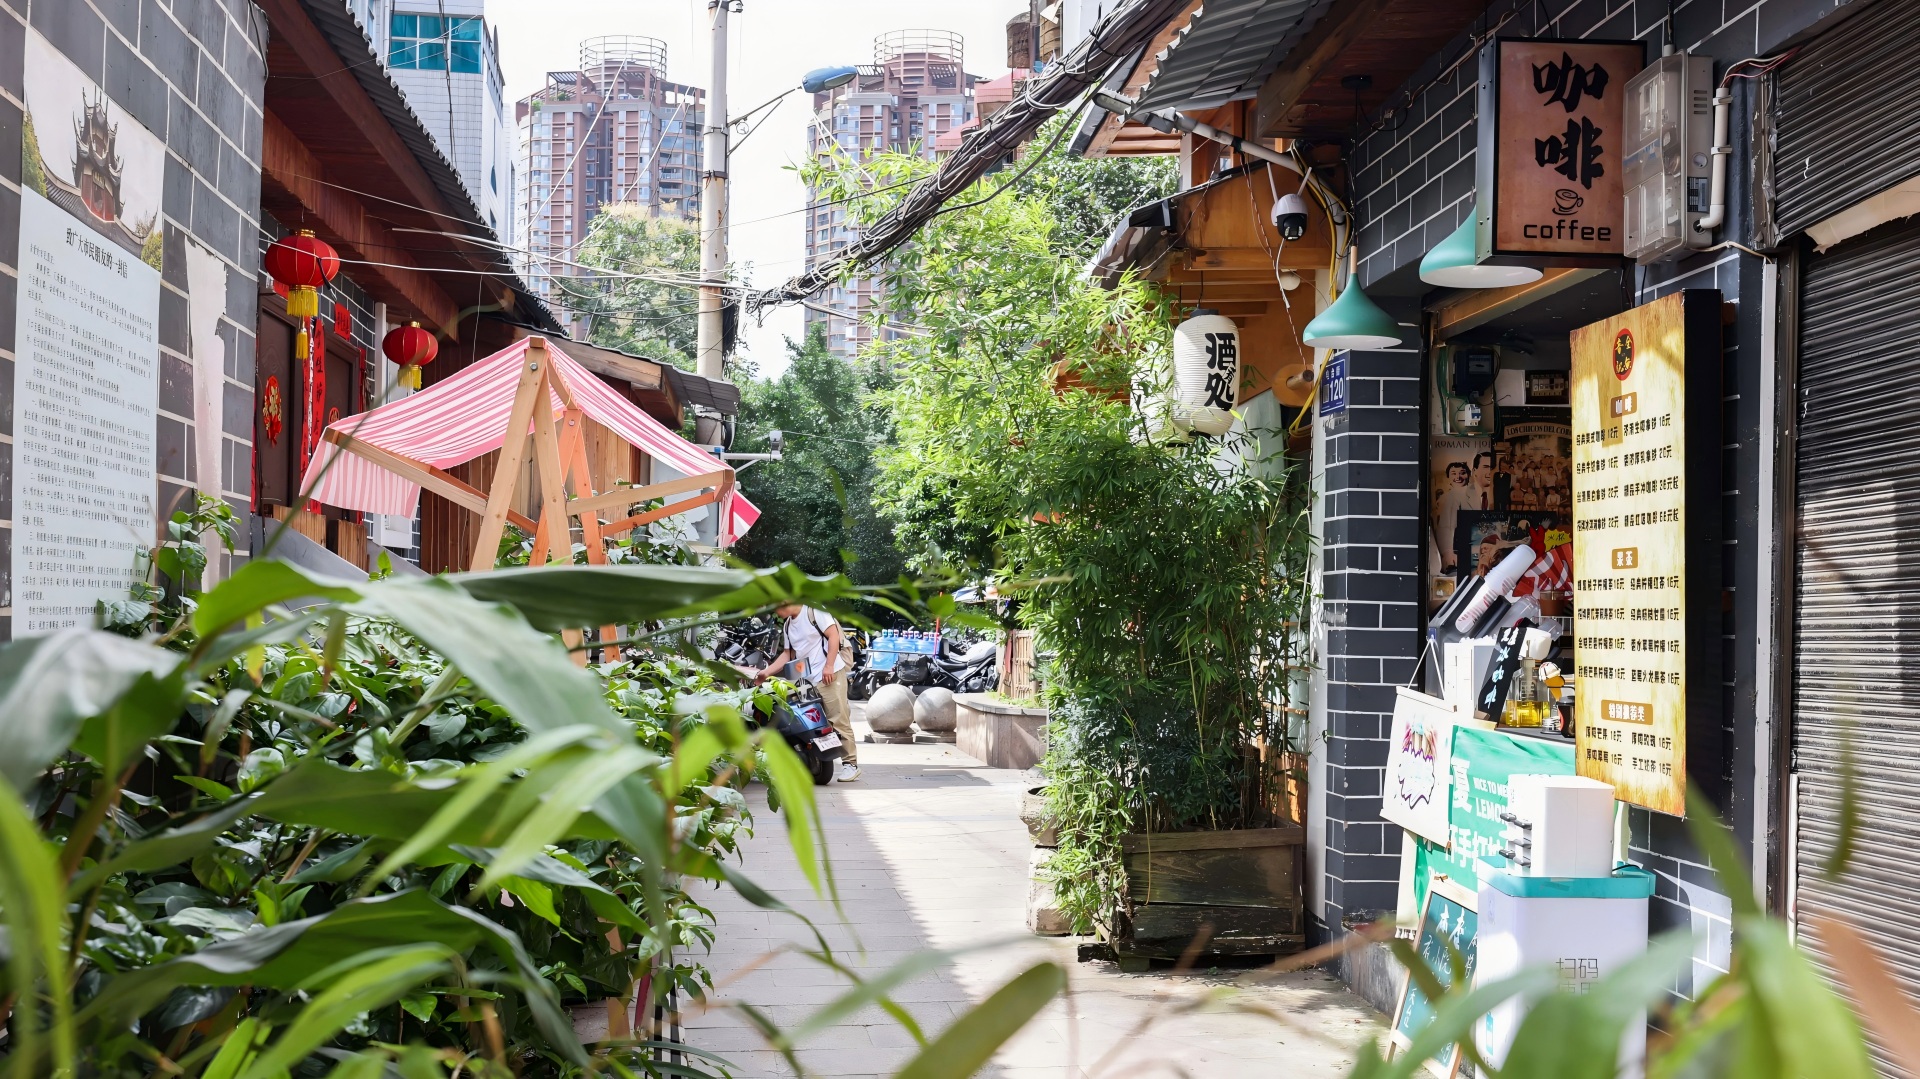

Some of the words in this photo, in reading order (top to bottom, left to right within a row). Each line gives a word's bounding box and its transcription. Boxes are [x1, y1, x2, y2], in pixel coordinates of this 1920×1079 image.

[1532, 51, 1609, 190] 咖啡
[1523, 219, 1611, 241] coffee
[66, 227, 128, 279] 致广大市民朋友的一封信
[1330, 377, 1344, 402] 120
[1615, 395, 1633, 415] 咖啡
[1506, 427, 1519, 436] LOS
[1435, 440, 1470, 449] ROMAN
[1616, 551, 1633, 567] 果茶
[1608, 703, 1645, 721] 特别推荐类
[1473, 777, 1488, 793] NICE
[1487, 780, 1497, 794] TO
[1555, 958, 1599, 979] 扫码
